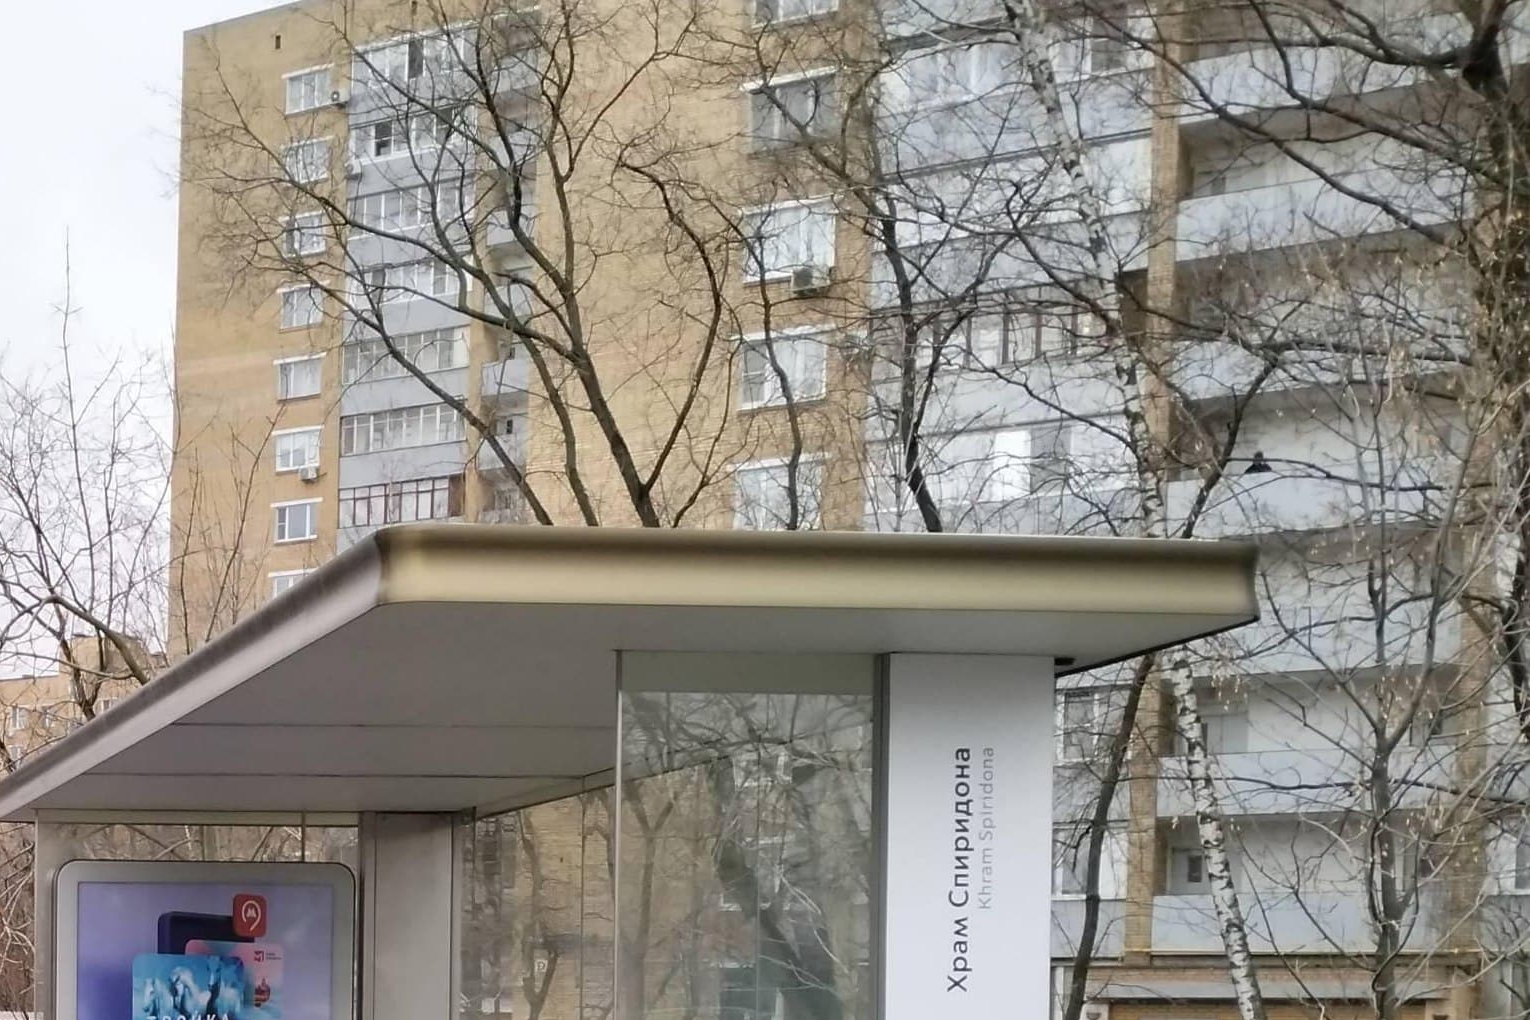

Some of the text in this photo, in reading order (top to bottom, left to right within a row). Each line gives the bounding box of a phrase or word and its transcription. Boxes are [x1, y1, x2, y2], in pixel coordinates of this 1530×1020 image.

[947, 747, 974, 992] Храм Спиридона
[977, 747, 996, 909] Khram Spiridona
